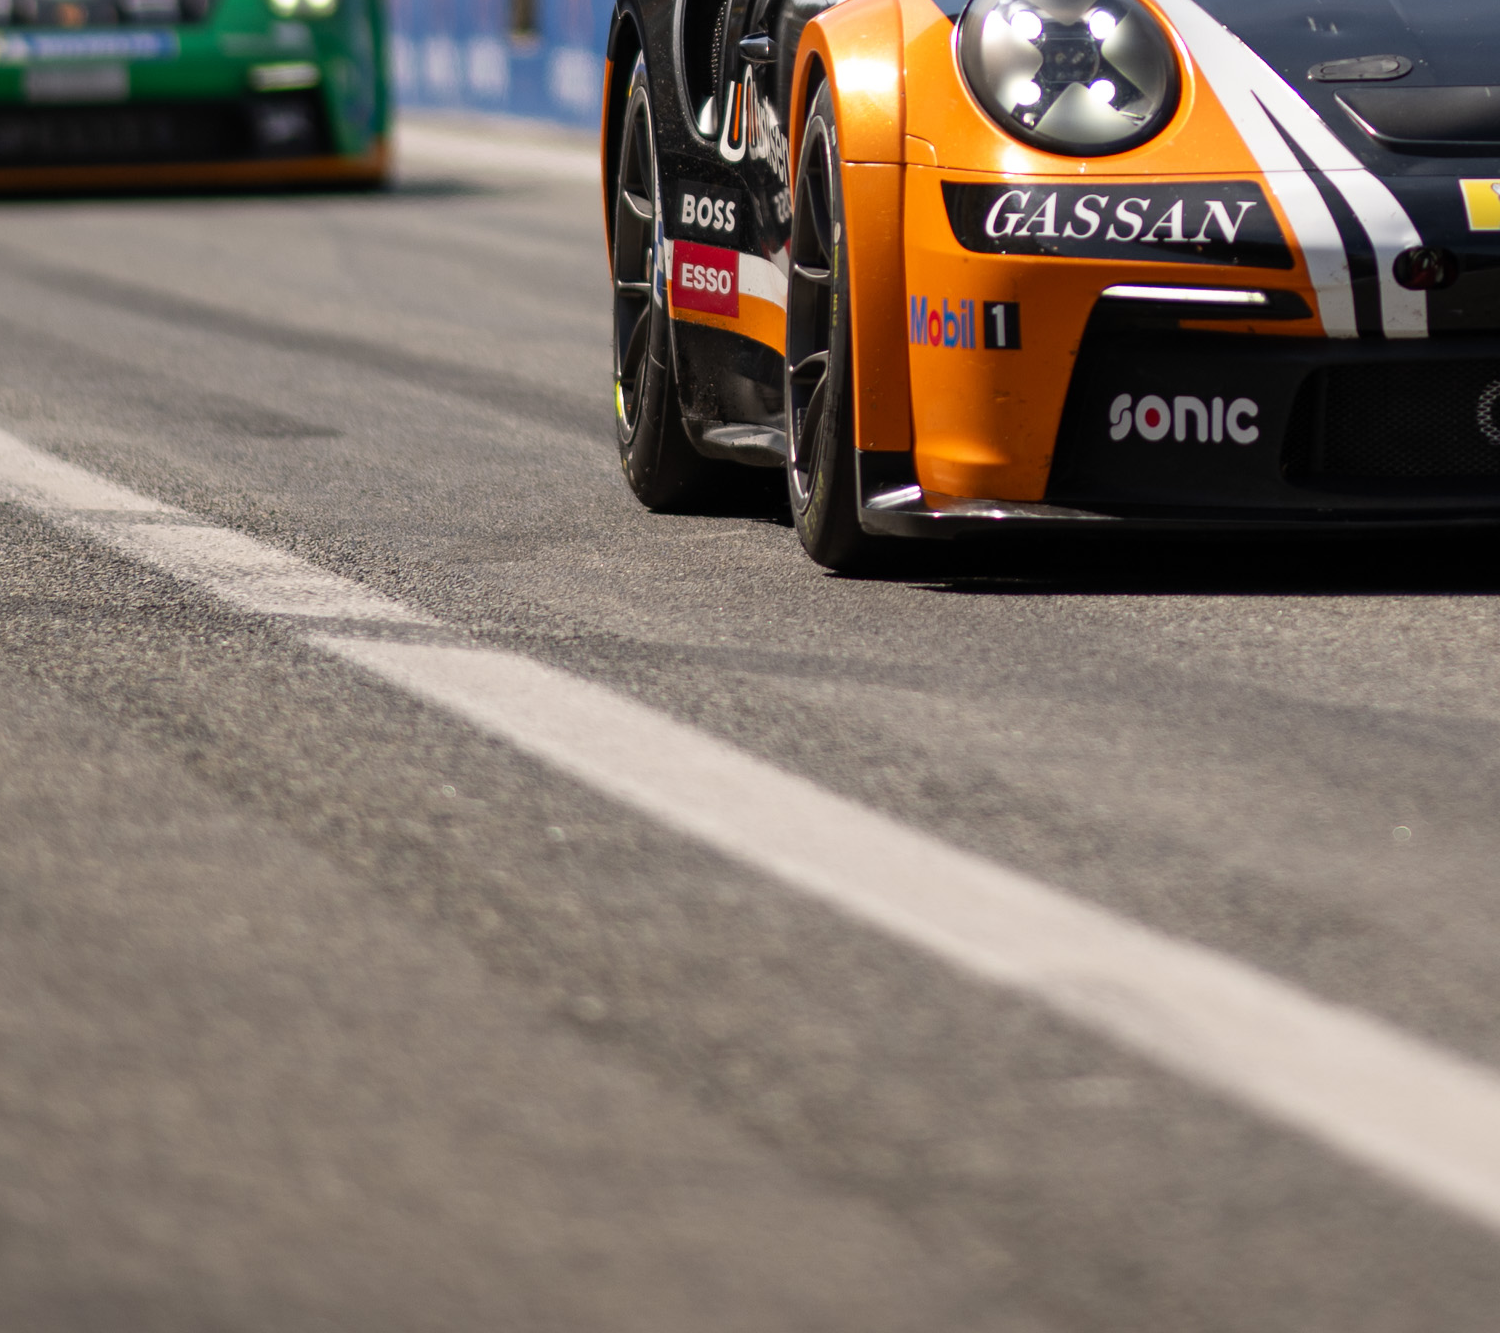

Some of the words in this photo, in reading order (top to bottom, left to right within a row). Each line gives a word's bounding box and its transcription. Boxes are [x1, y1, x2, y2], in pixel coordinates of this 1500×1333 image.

[681, 193, 737, 233] BOSS
[984, 189, 1258, 244] GASSAN
[680, 262, 732, 295] ESSO
[910, 295, 976, 349] Mobil
